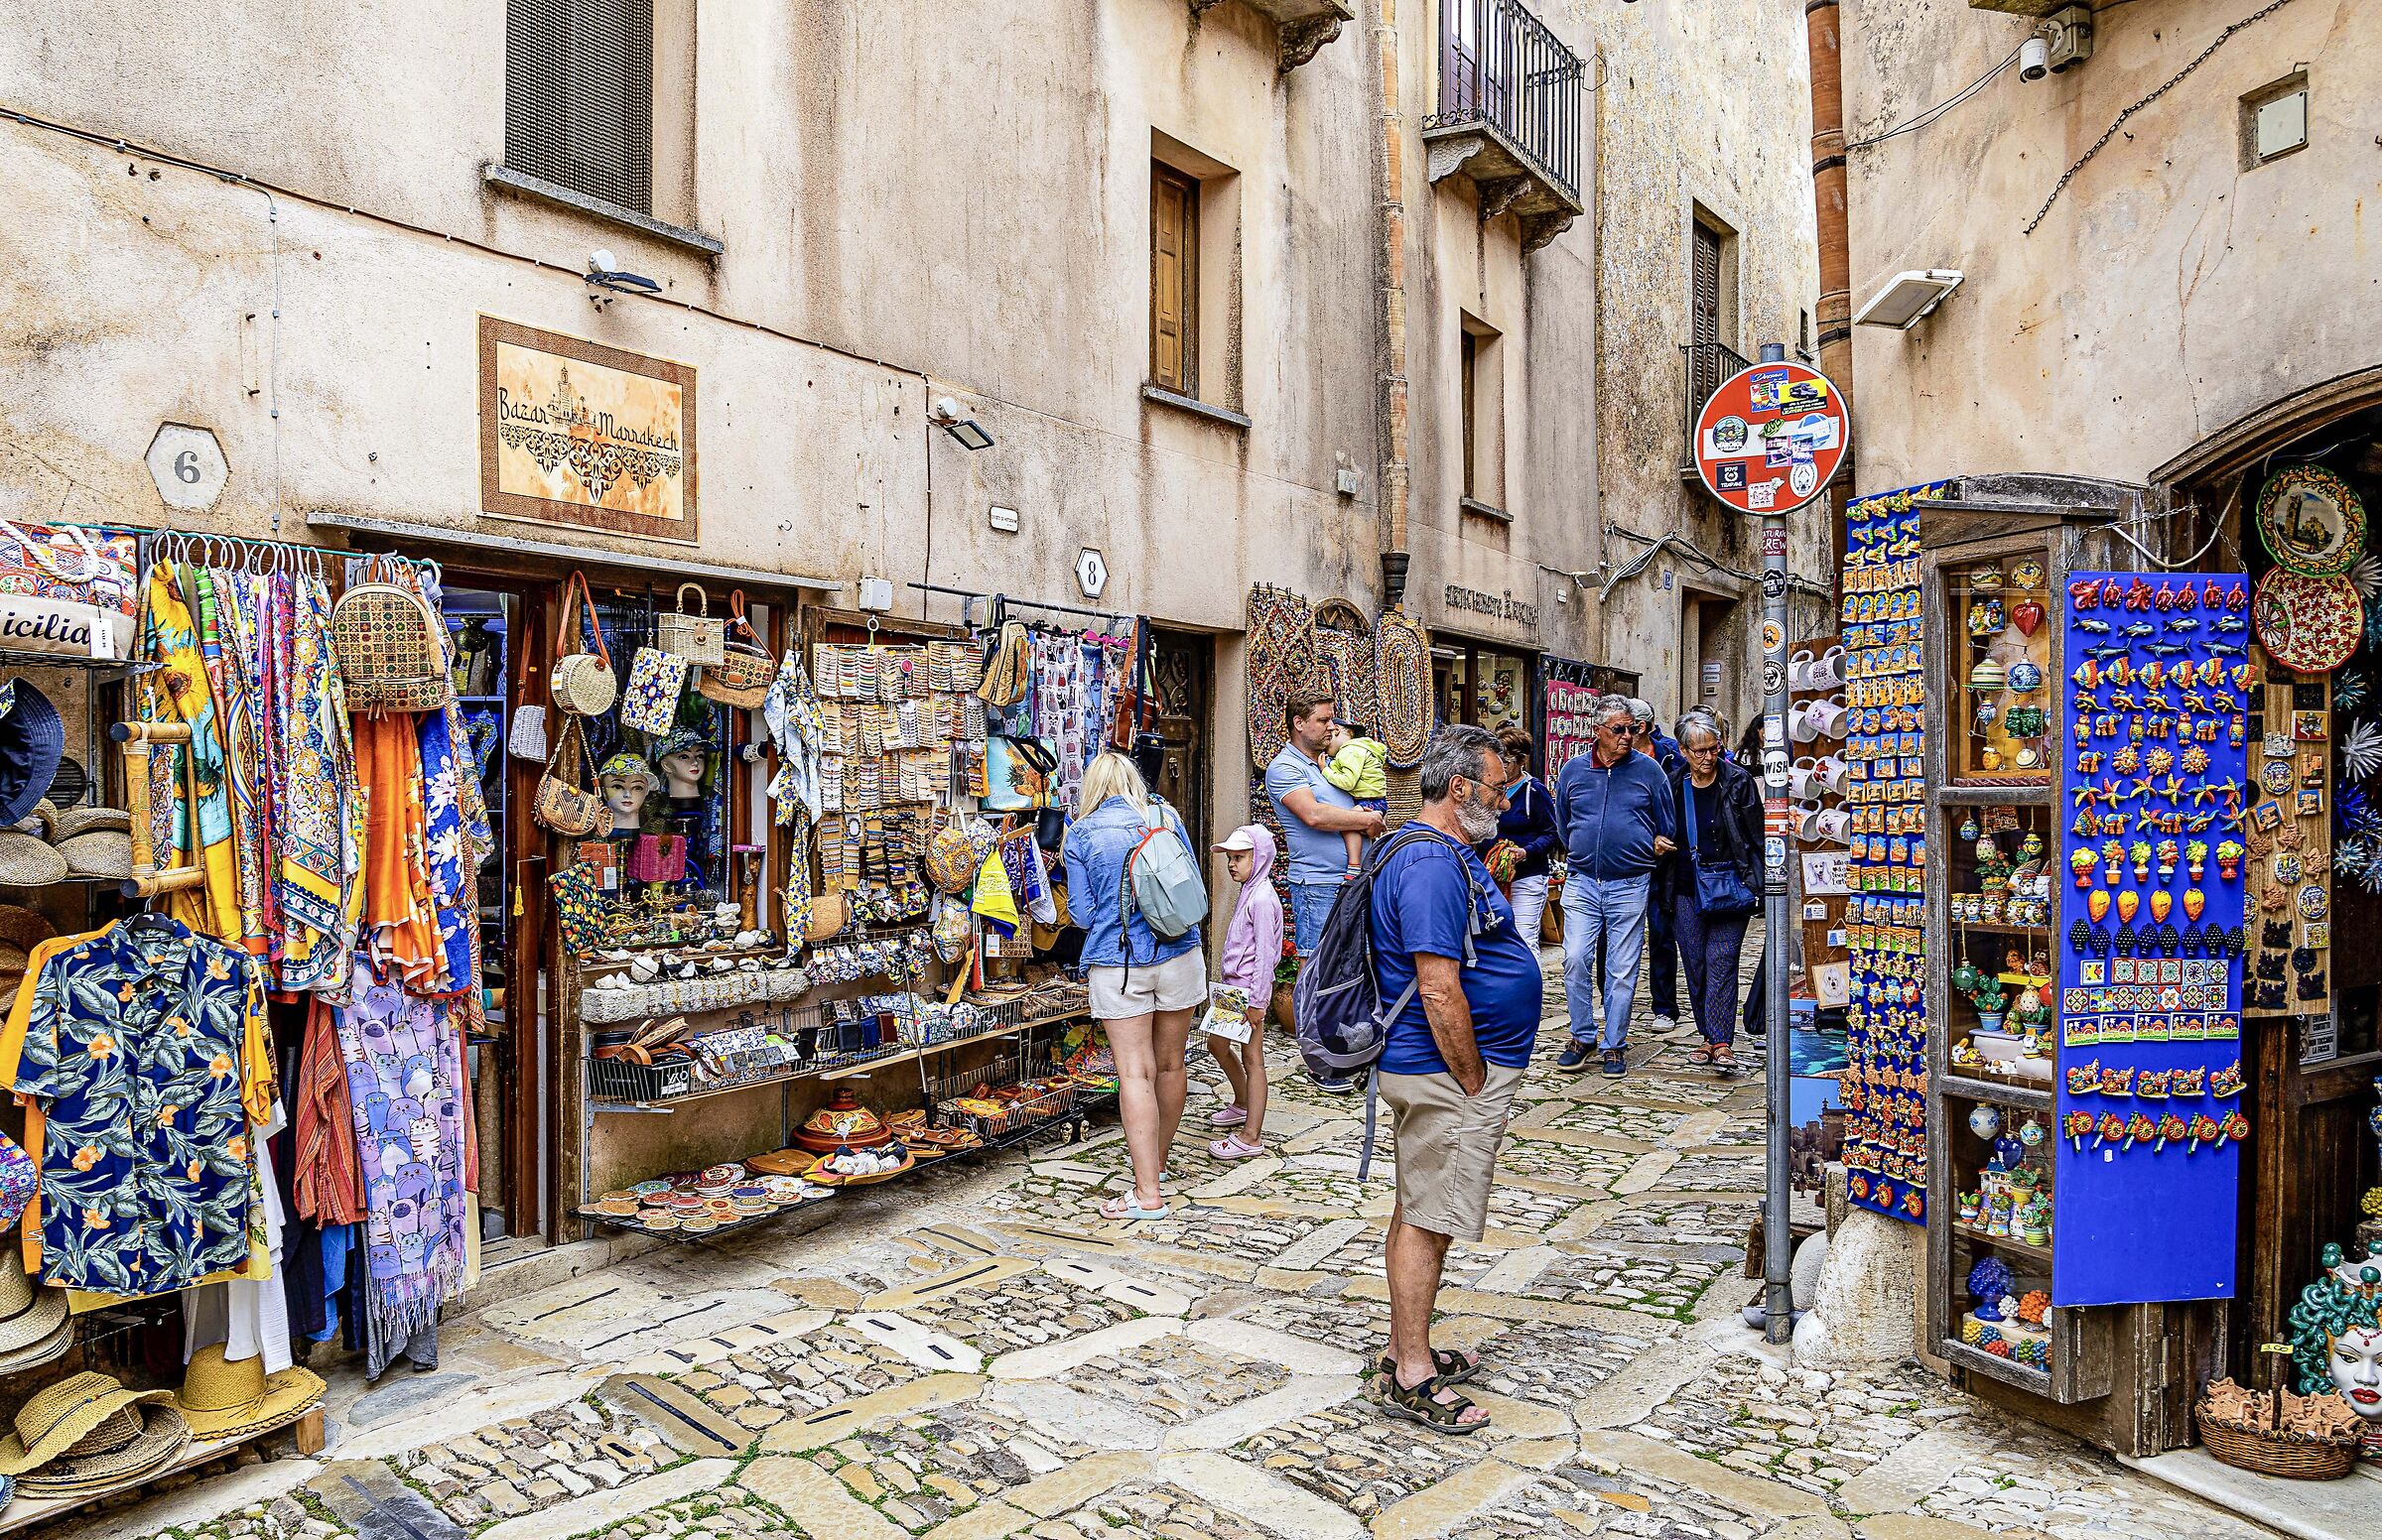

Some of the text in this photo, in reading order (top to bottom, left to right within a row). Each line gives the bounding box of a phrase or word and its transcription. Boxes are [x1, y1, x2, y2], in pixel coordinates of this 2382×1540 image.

[498, 387, 679, 451] Bazar Marrakech
[175, 450, 200, 483] 6
[1088, 561, 1097, 585] 8
[0, 611, 90, 645] icilia
